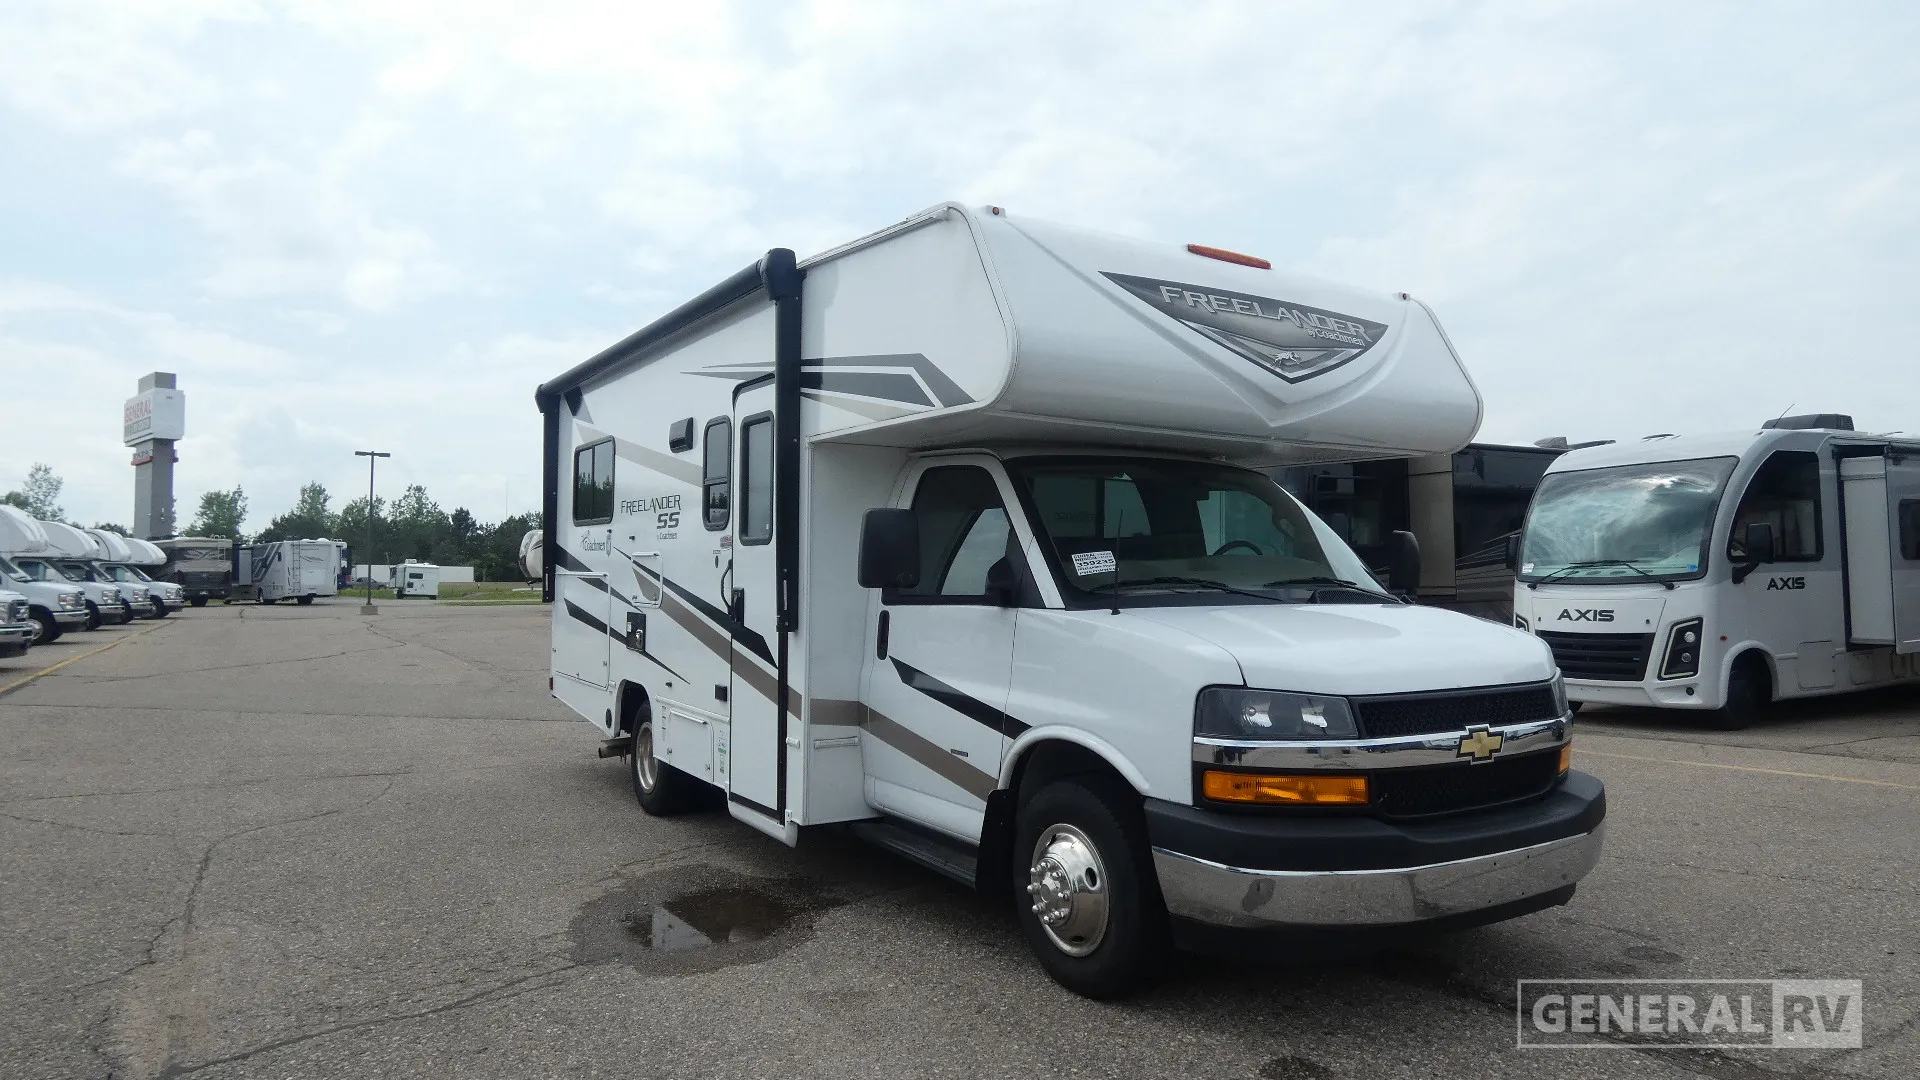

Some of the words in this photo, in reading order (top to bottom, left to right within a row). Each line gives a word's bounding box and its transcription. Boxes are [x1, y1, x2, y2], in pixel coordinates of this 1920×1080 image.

[1159, 285, 1372, 342] FREELANDER
[1315, 328, 1366, 347] Coachmen
[124, 398, 152, 423] GENERAL
[621, 495, 681, 515] FREELANDER
[656, 511, 681, 530] SS
[584, 538, 606, 551] Coachmen
[1767, 576, 1806, 590] AXIS
[1557, 608, 1615, 622] AXIS
